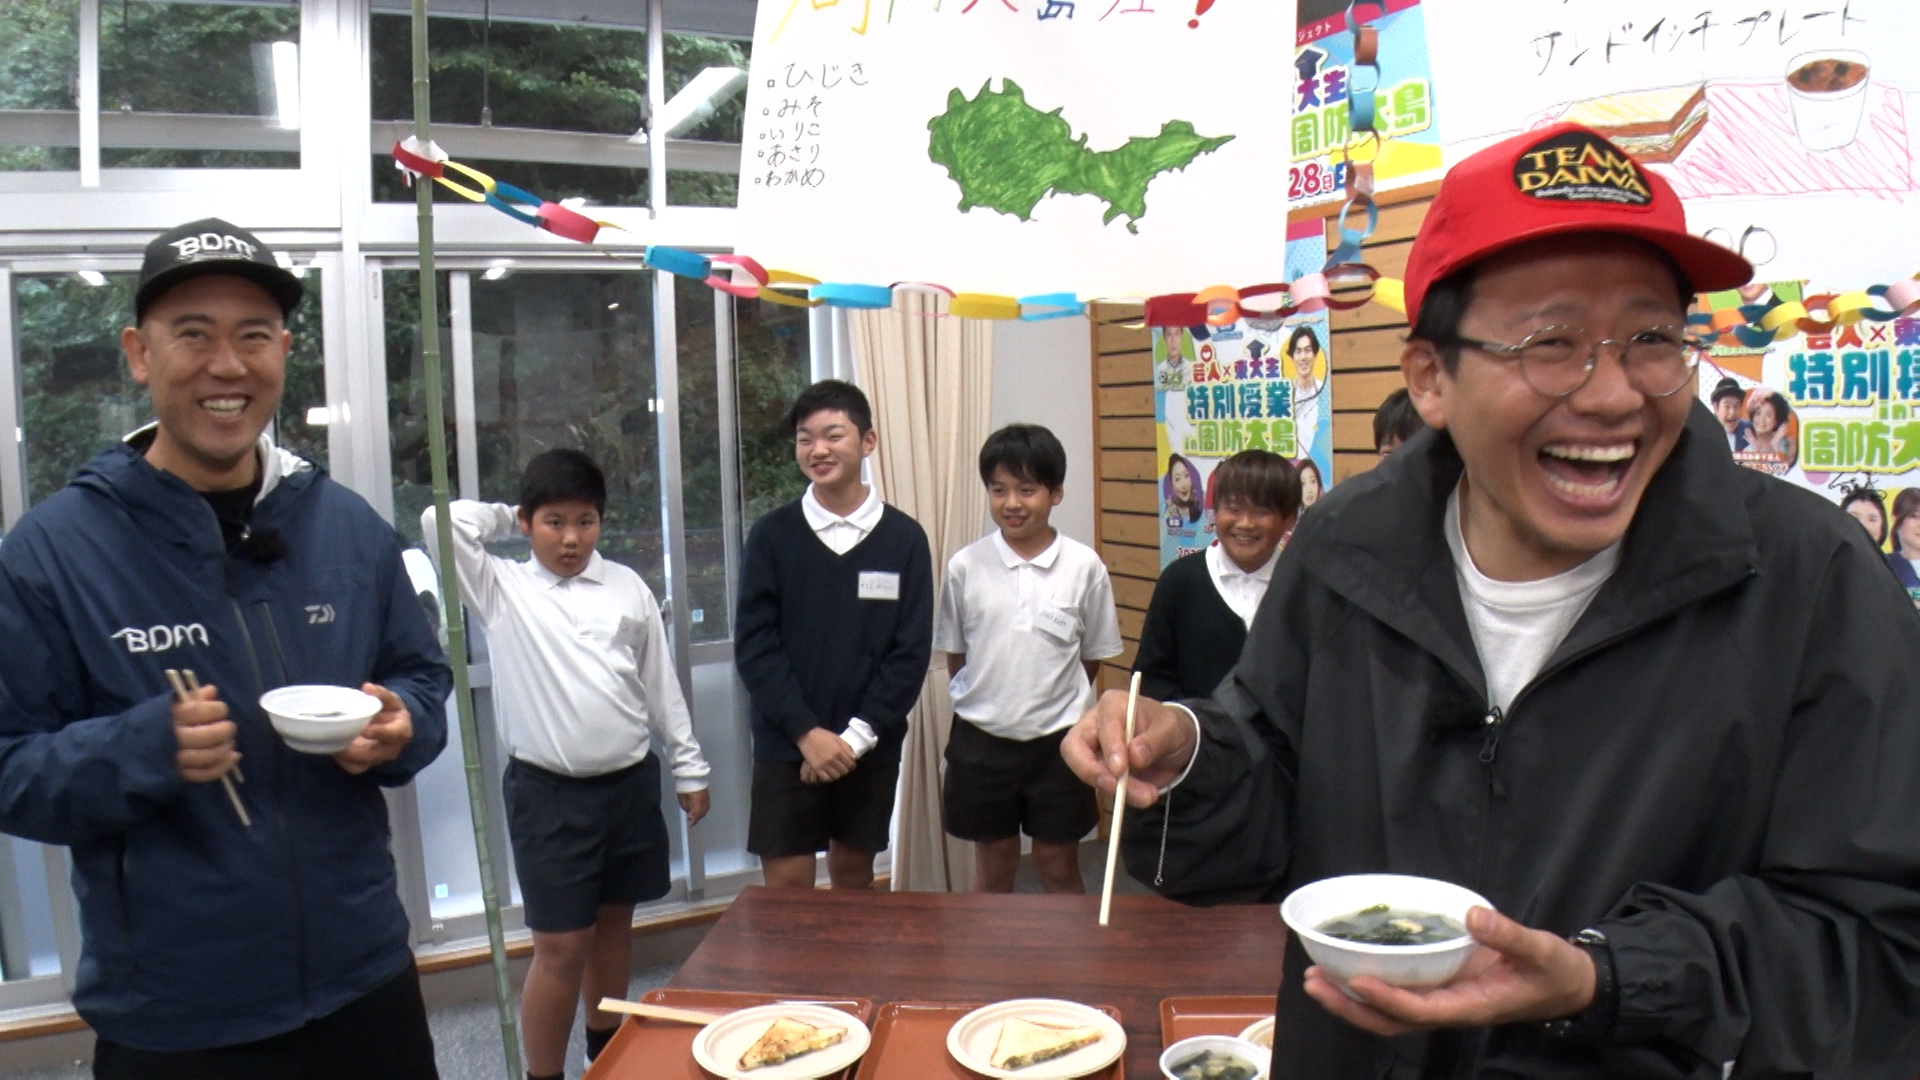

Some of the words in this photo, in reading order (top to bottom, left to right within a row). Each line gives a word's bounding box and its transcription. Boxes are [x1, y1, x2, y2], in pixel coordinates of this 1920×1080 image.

[784, 61, 869, 89] ひじき
[777, 95, 822, 118] みそ
[769, 121, 821, 142] いりこ
[767, 143, 820, 168] あさり
[1521, 142, 1638, 177] TEAM
[765, 167, 825, 188] わかめ
[1518, 166, 1652, 198] DAIWA
[1186, 381, 1293, 420] 特別授業
[1879, 401, 1907, 420] in
[1199, 420, 1296, 452] 周防大島
[110, 623, 210, 652] BDM
